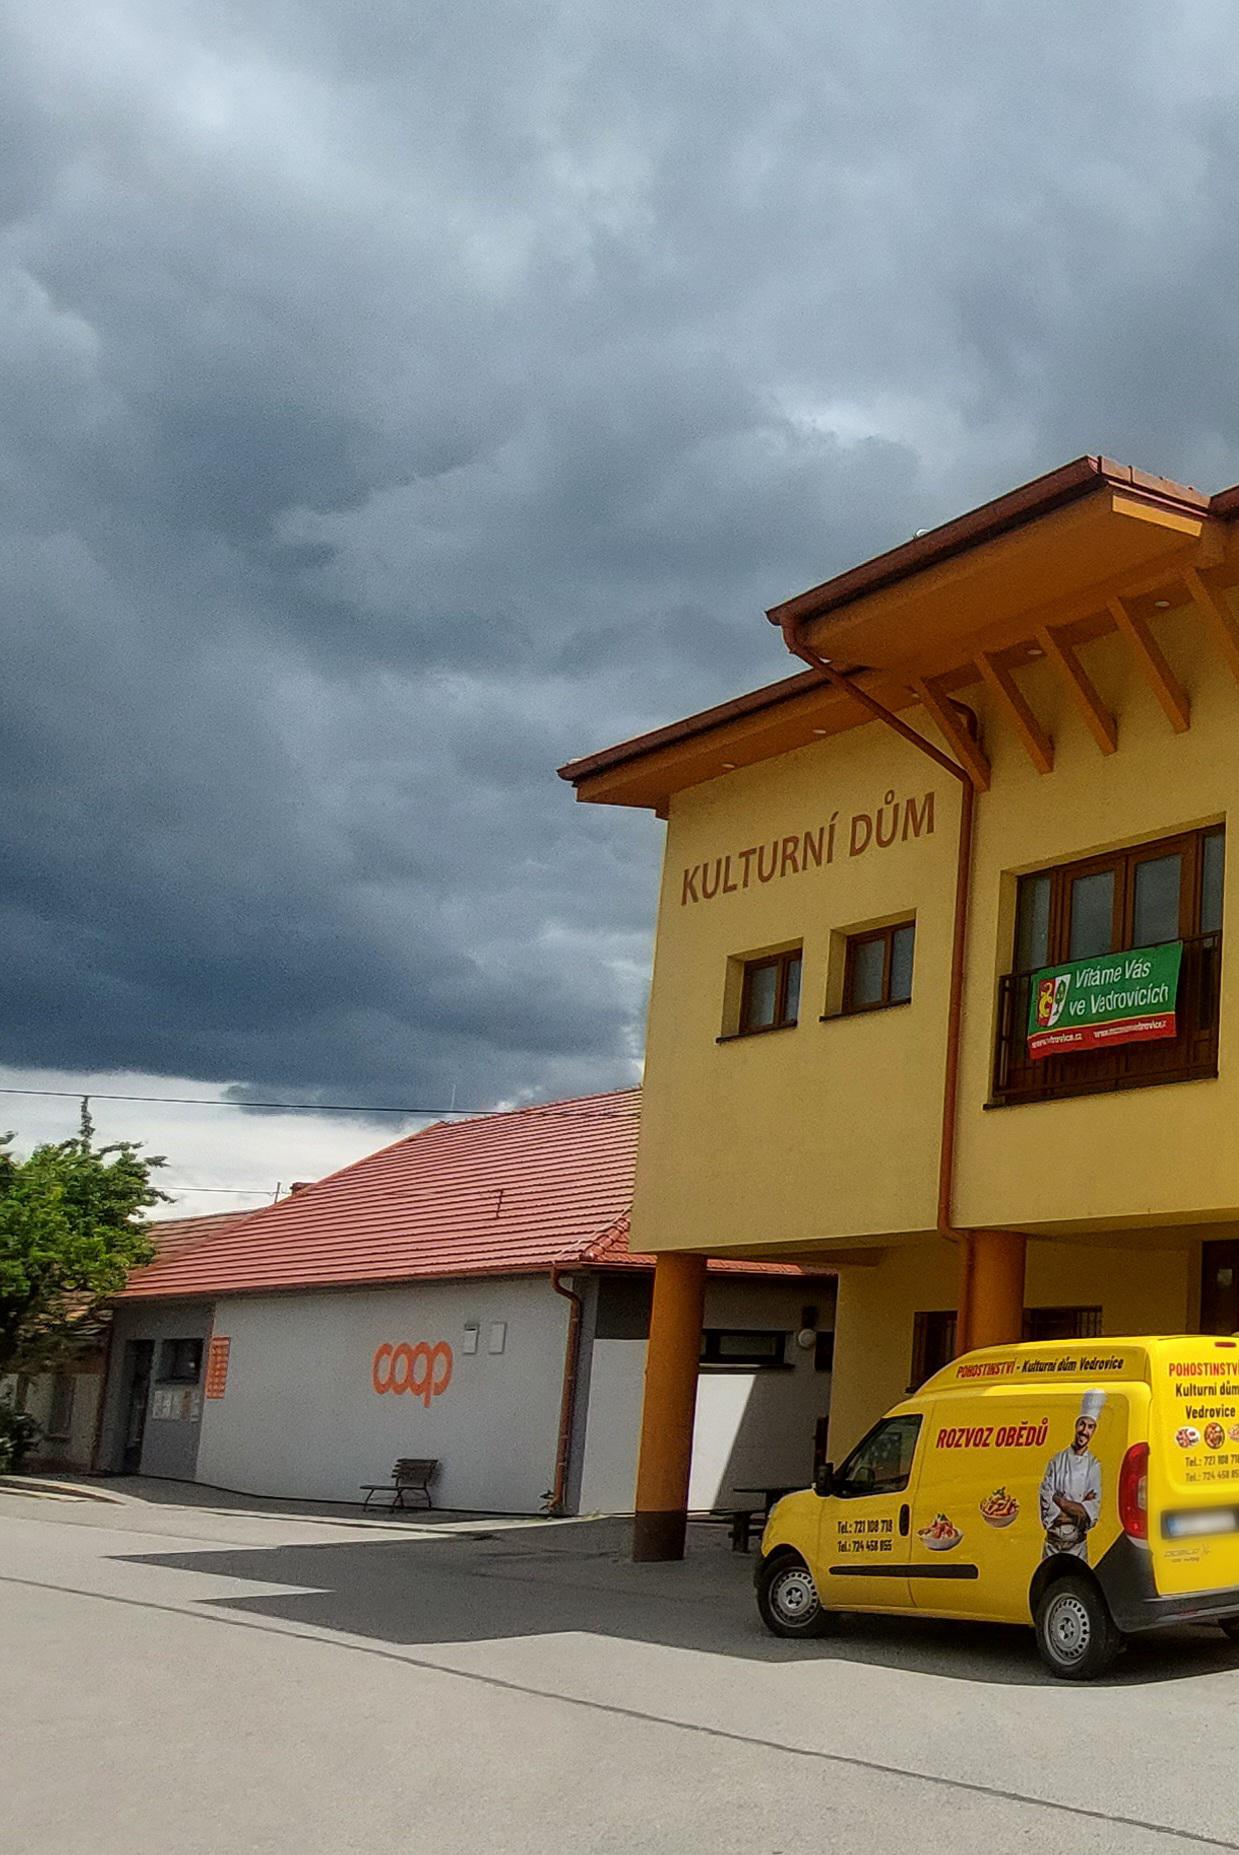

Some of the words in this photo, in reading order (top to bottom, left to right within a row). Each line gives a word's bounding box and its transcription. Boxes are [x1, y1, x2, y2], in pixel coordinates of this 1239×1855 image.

[681, 811, 839, 906] KULTURNÍ
[849, 789, 935, 857] DŮM
[1075, 965, 1122, 988] Vítáme
[1124, 958, 1151, 979] Vás
[1069, 999, 1086, 1016] ve
[1090, 983, 1169, 1014] Vedrovicích
[373, 1341, 453, 1408] coop
[956, 1357, 1017, 1379] POHOSTINSTVÍ
[1021, 1357, 1057, 1373] Kulturní
[1057, 1355, 1077, 1371] dům
[1079, 1355, 1124, 1371] Vedrovice
[1175, 1382, 1217, 1397] Kulturní
[1220, 1380, 1239, 1395] dům
[1185, 1404, 1236, 1419] Vedrovice
[936, 1427, 994, 1448] ROZVOZ
[995, 1417, 1048, 1447] OBĚDŮ
[854, 1520, 866, 1533] 721
